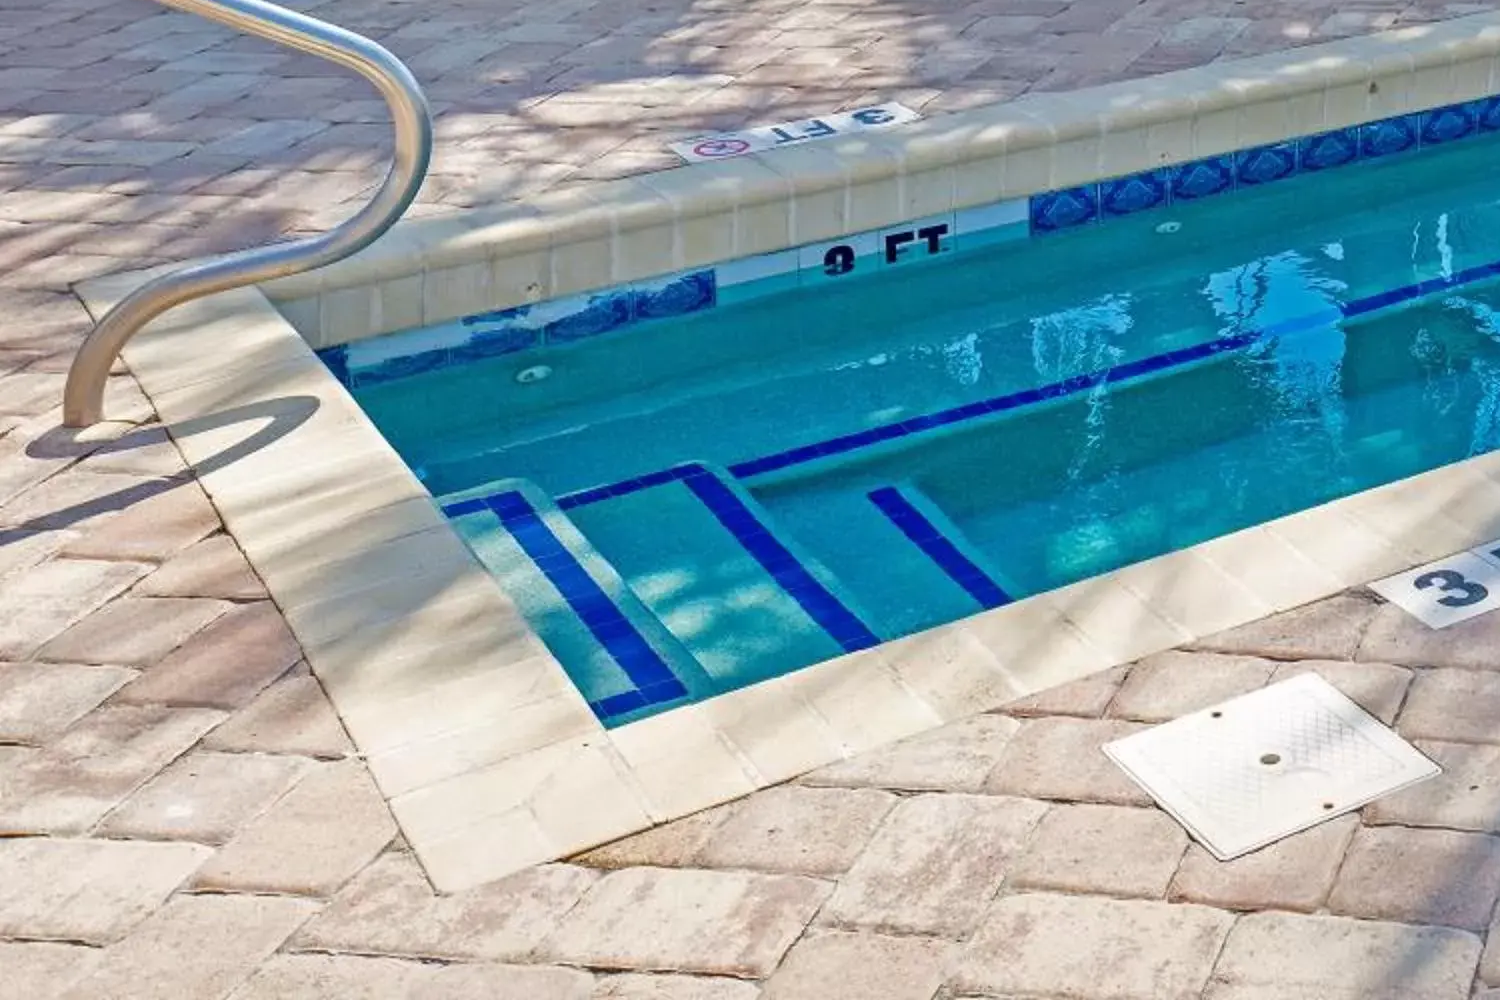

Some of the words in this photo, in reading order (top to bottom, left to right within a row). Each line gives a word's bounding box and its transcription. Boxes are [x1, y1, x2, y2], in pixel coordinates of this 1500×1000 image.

[852, 108, 895, 126] 3
[771, 119, 838, 145] FT
[1412, 569, 1489, 608] 3
